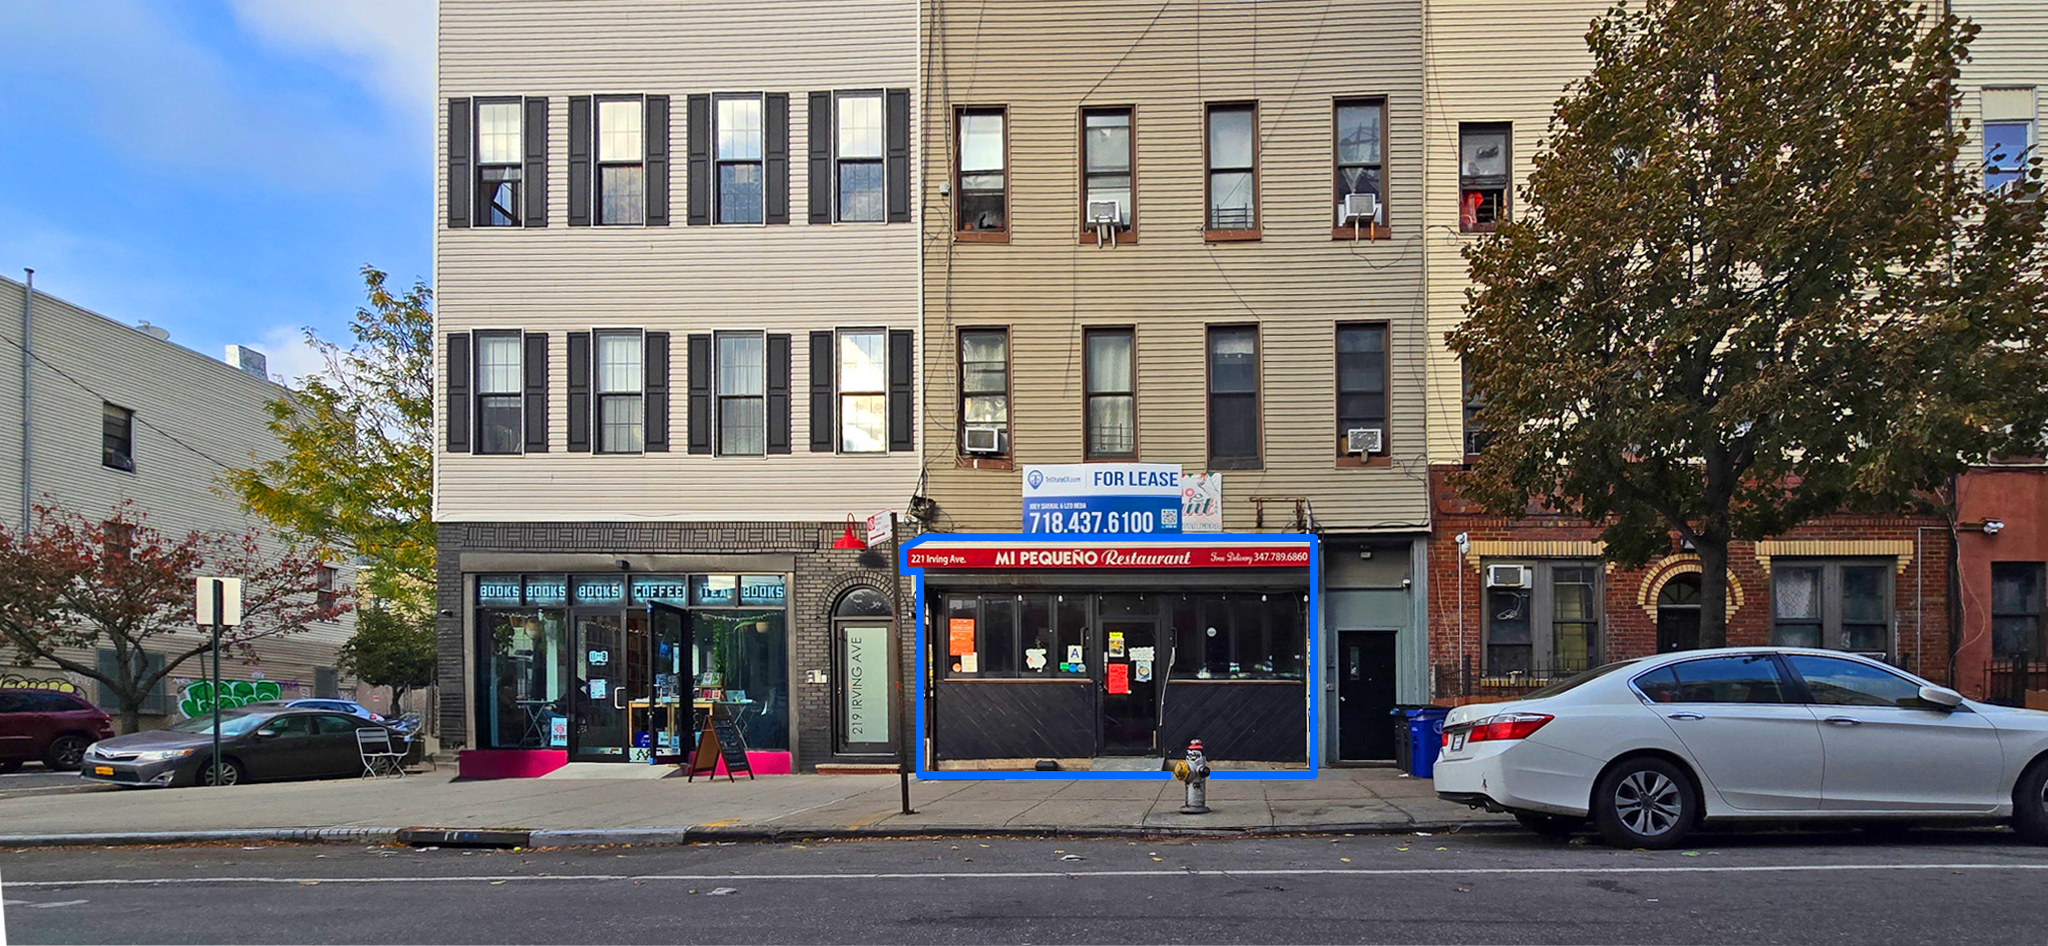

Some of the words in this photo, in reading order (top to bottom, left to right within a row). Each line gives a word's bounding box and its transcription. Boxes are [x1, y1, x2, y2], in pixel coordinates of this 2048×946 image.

[1094, 471, 1124, 486] FOR
[1129, 471, 1179, 487] LEASE
[1029, 511, 1154, 533] 718.437.6100
[911, 554, 925, 563] 221
[926, 554, 949, 566] Irving
[949, 555, 967, 564] Ave.
[995, 551, 1016, 566] MI
[1020, 549, 1098, 566] PEQUEÑO
[1101, 549, 1192, 566] Restaurant
[1210, 551, 1227, 563] Free
[1227, 552, 1254, 565] Delivery
[1254, 551, 1309, 562] 347.789.6860
[480, 585, 519, 597] BOOKS
[526, 585, 566, 597] BOOKS
[578, 585, 619, 597] BOOKS
[633, 585, 683, 597] COFFEE
[702, 586, 729, 597] TEA
[742, 586, 784, 597] BOOKS
[851, 637, 862, 663] AVE
[1070, 648, 1080, 658] A
[851, 666, 863, 710] IRVING
[852, 714, 863, 735] 219
